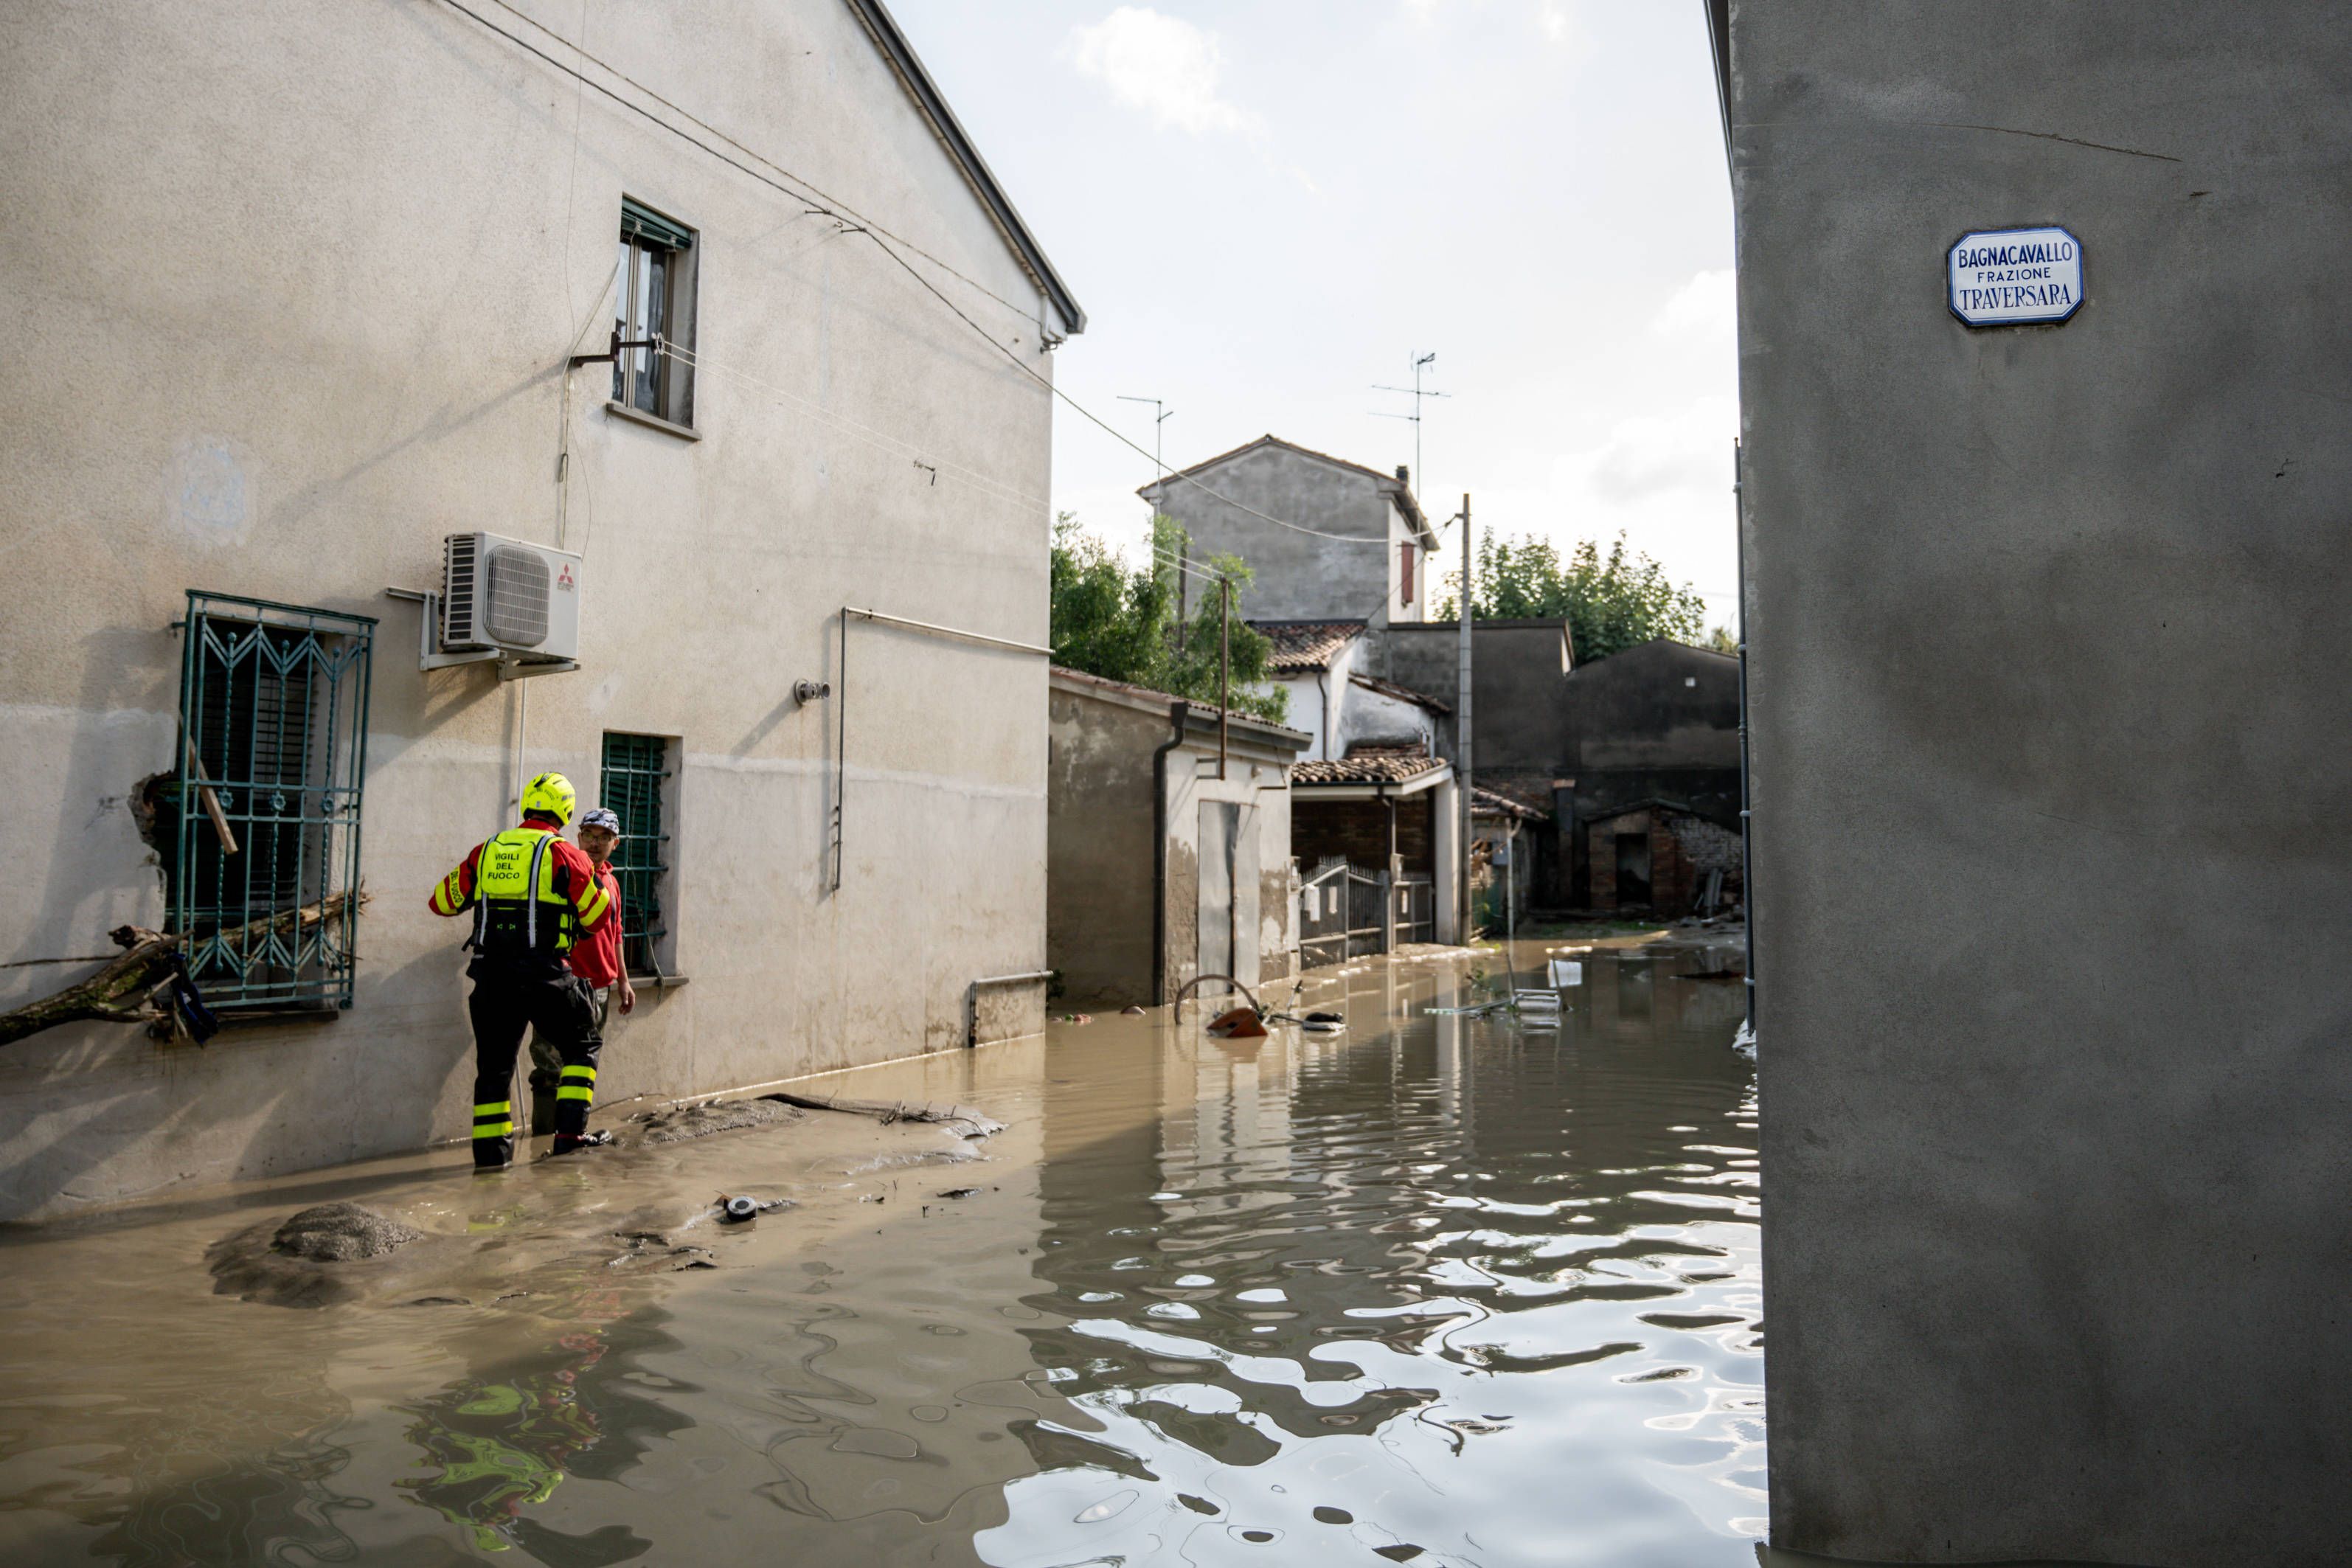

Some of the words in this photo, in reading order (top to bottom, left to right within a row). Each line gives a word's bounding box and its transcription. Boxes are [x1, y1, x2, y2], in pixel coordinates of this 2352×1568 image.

[1958, 242, 2072, 268] BAGNACAVALLO
[1977, 267, 2051, 283] FRAZIONE
[1960, 283, 2072, 311] TRAVERSARA
[495, 853, 519, 861] VIGILI
